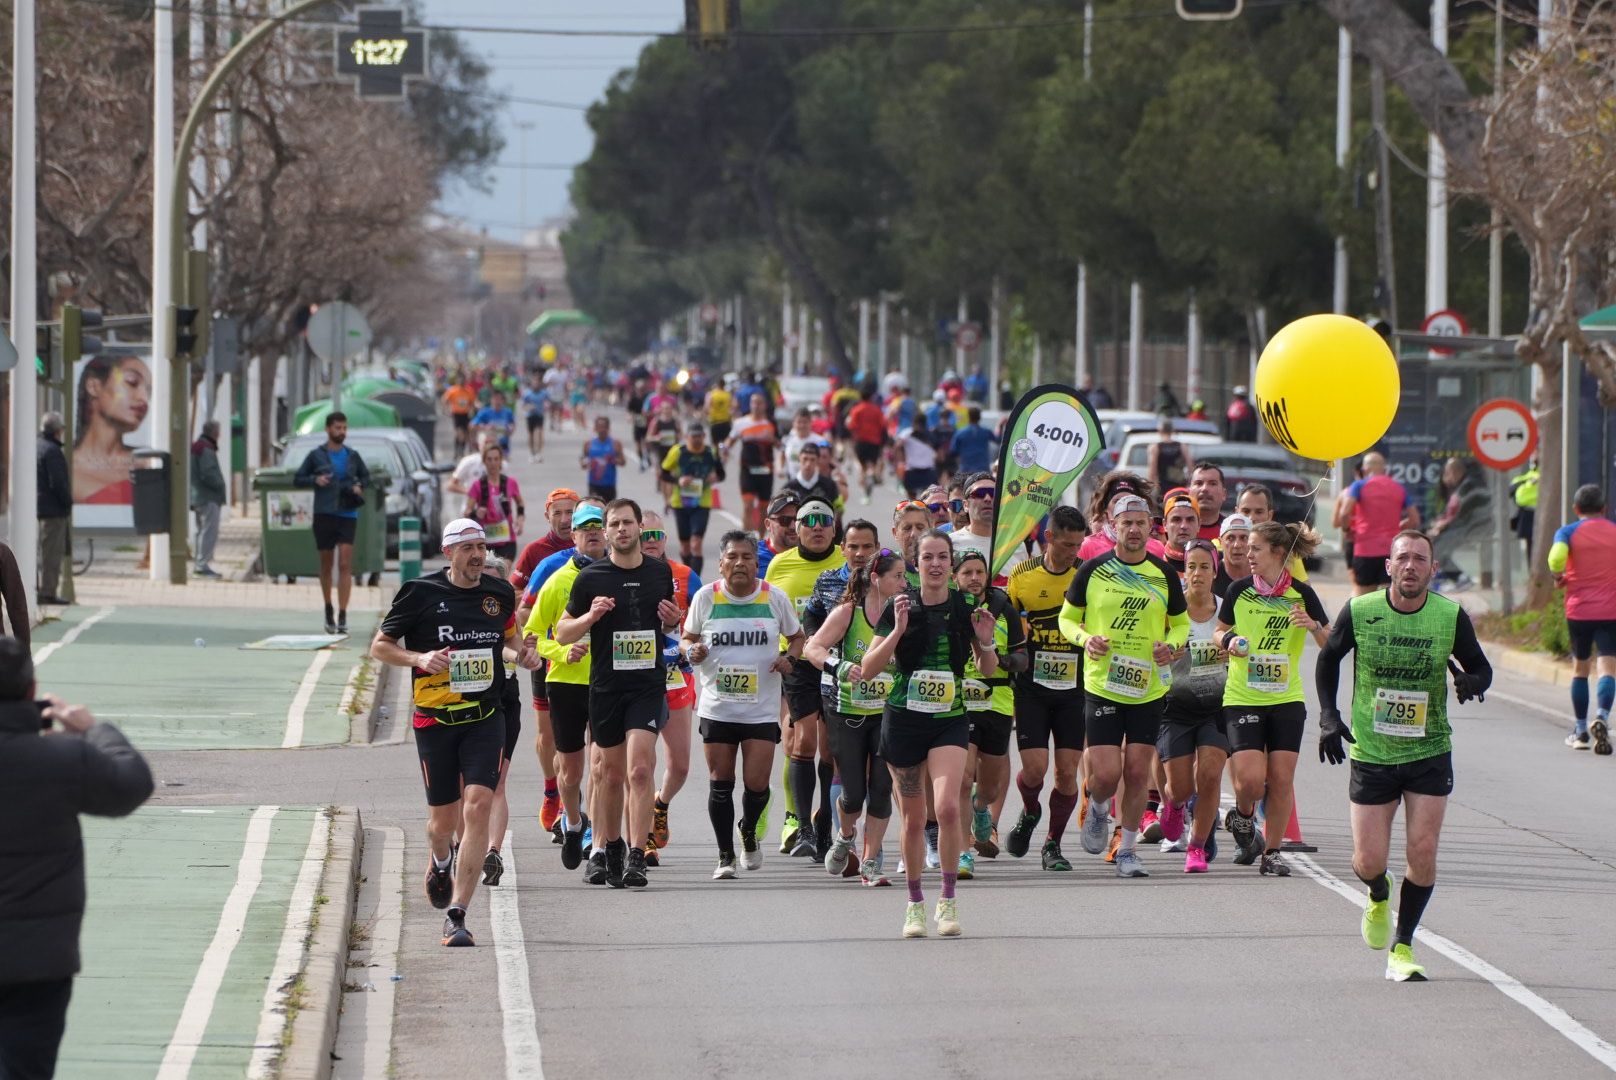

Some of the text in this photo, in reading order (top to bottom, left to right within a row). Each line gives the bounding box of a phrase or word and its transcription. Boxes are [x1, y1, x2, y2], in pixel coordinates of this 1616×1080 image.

[1033, 423, 1083, 448] 4:00h
[1120, 596, 1150, 610] RUN
[1110, 617, 1140, 631] LIFE
[1265, 616, 1292, 629] RUN
[712, 631, 769, 647] BOLIVIA
[1257, 637, 1285, 650] LIFE
[618, 640, 651, 655] 1022
[455, 660, 488, 676] 1130
[1043, 662, 1067, 676] 942
[1116, 665, 1142, 682] 966
[1256, 664, 1282, 678] 915
[724, 674, 749, 689] 972
[860, 681, 885, 695] 943
[918, 681, 945, 697] 628
[1386, 701, 1416, 719] 795
